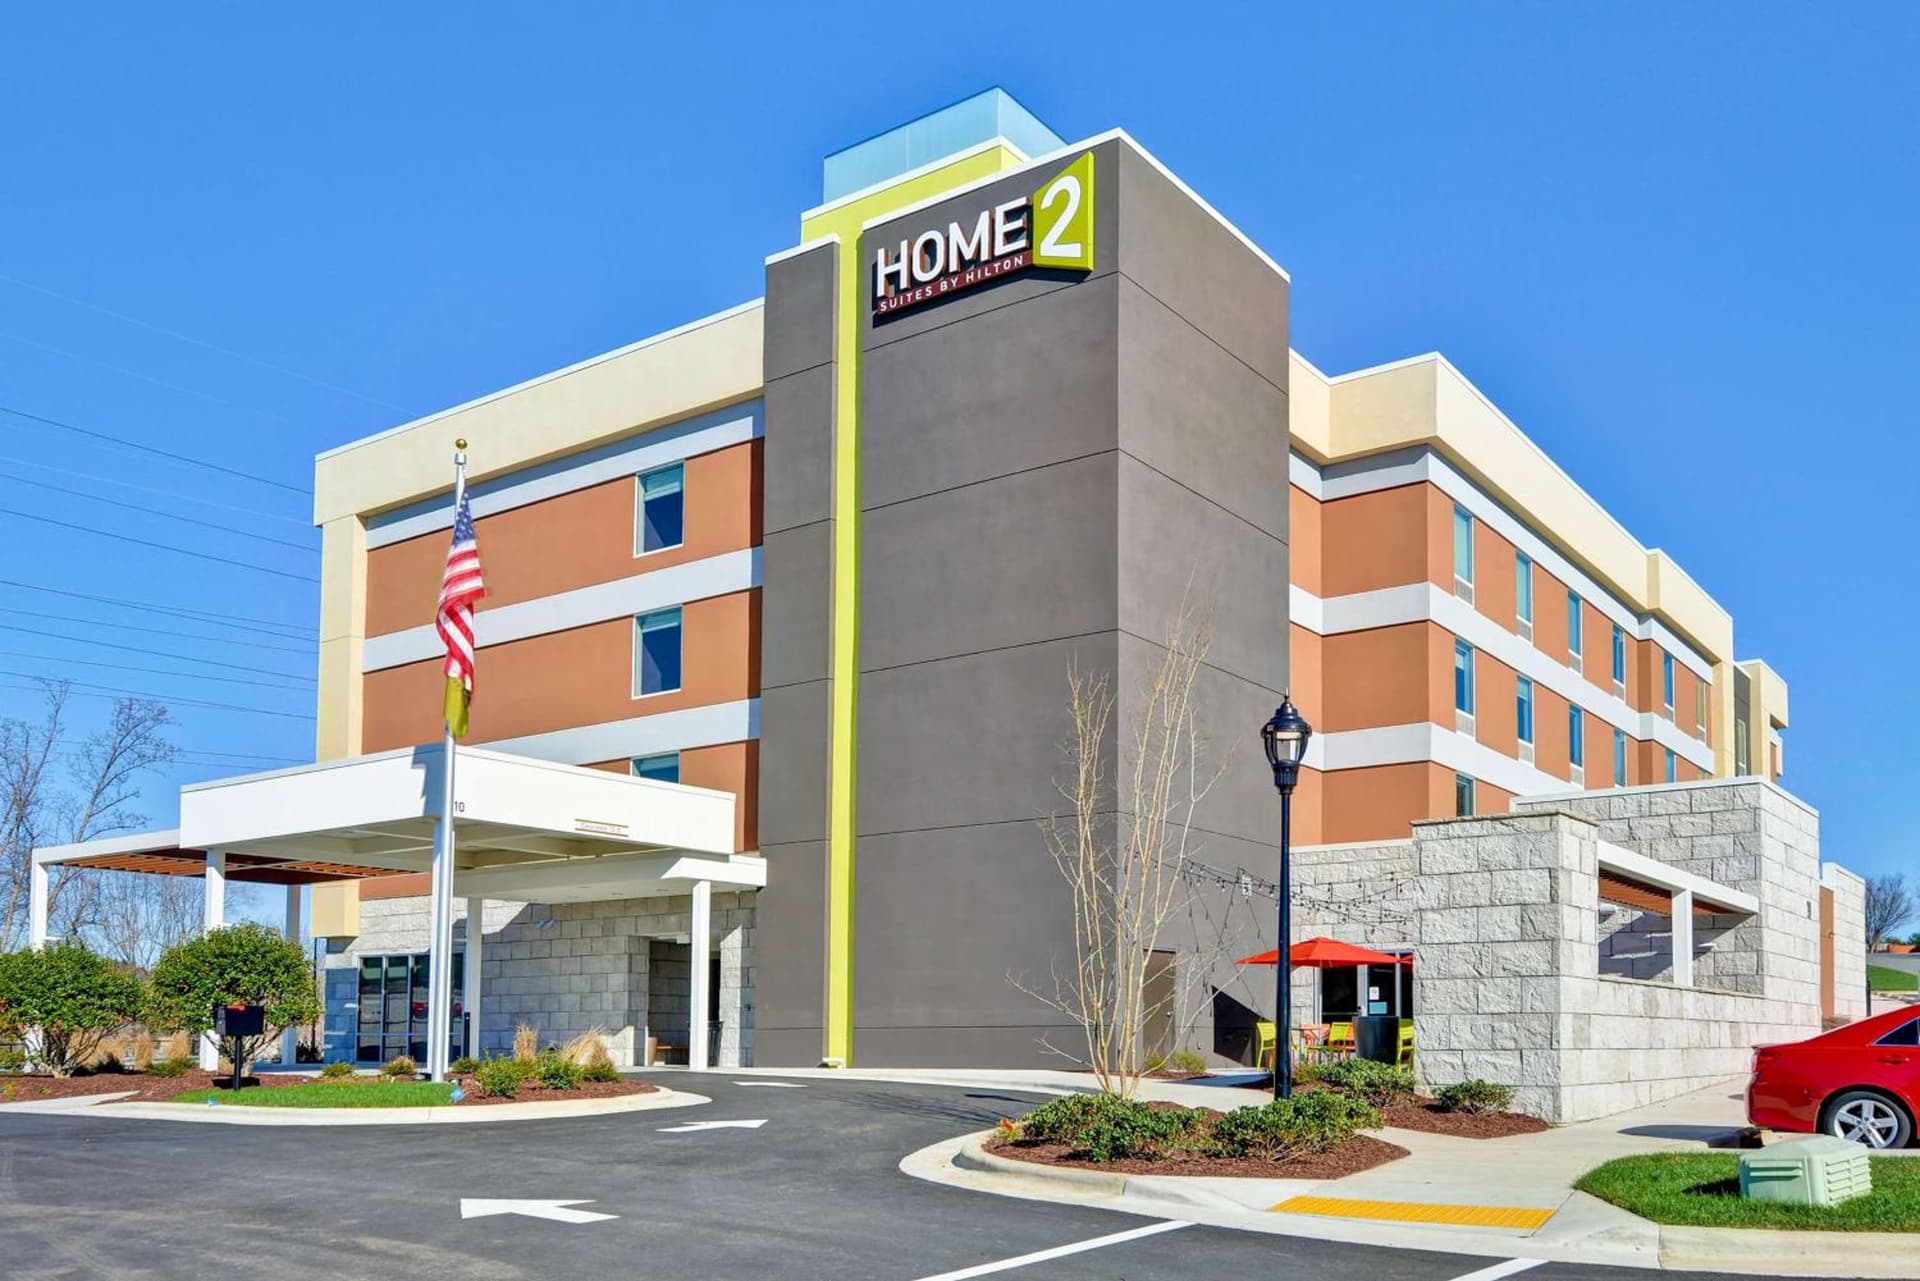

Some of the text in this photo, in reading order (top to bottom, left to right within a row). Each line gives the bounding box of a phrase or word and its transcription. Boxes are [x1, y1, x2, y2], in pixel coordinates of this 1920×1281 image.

[877, 175, 1082, 297] HOME 2
[880, 255, 1024, 312] SUITES BY HILTON
